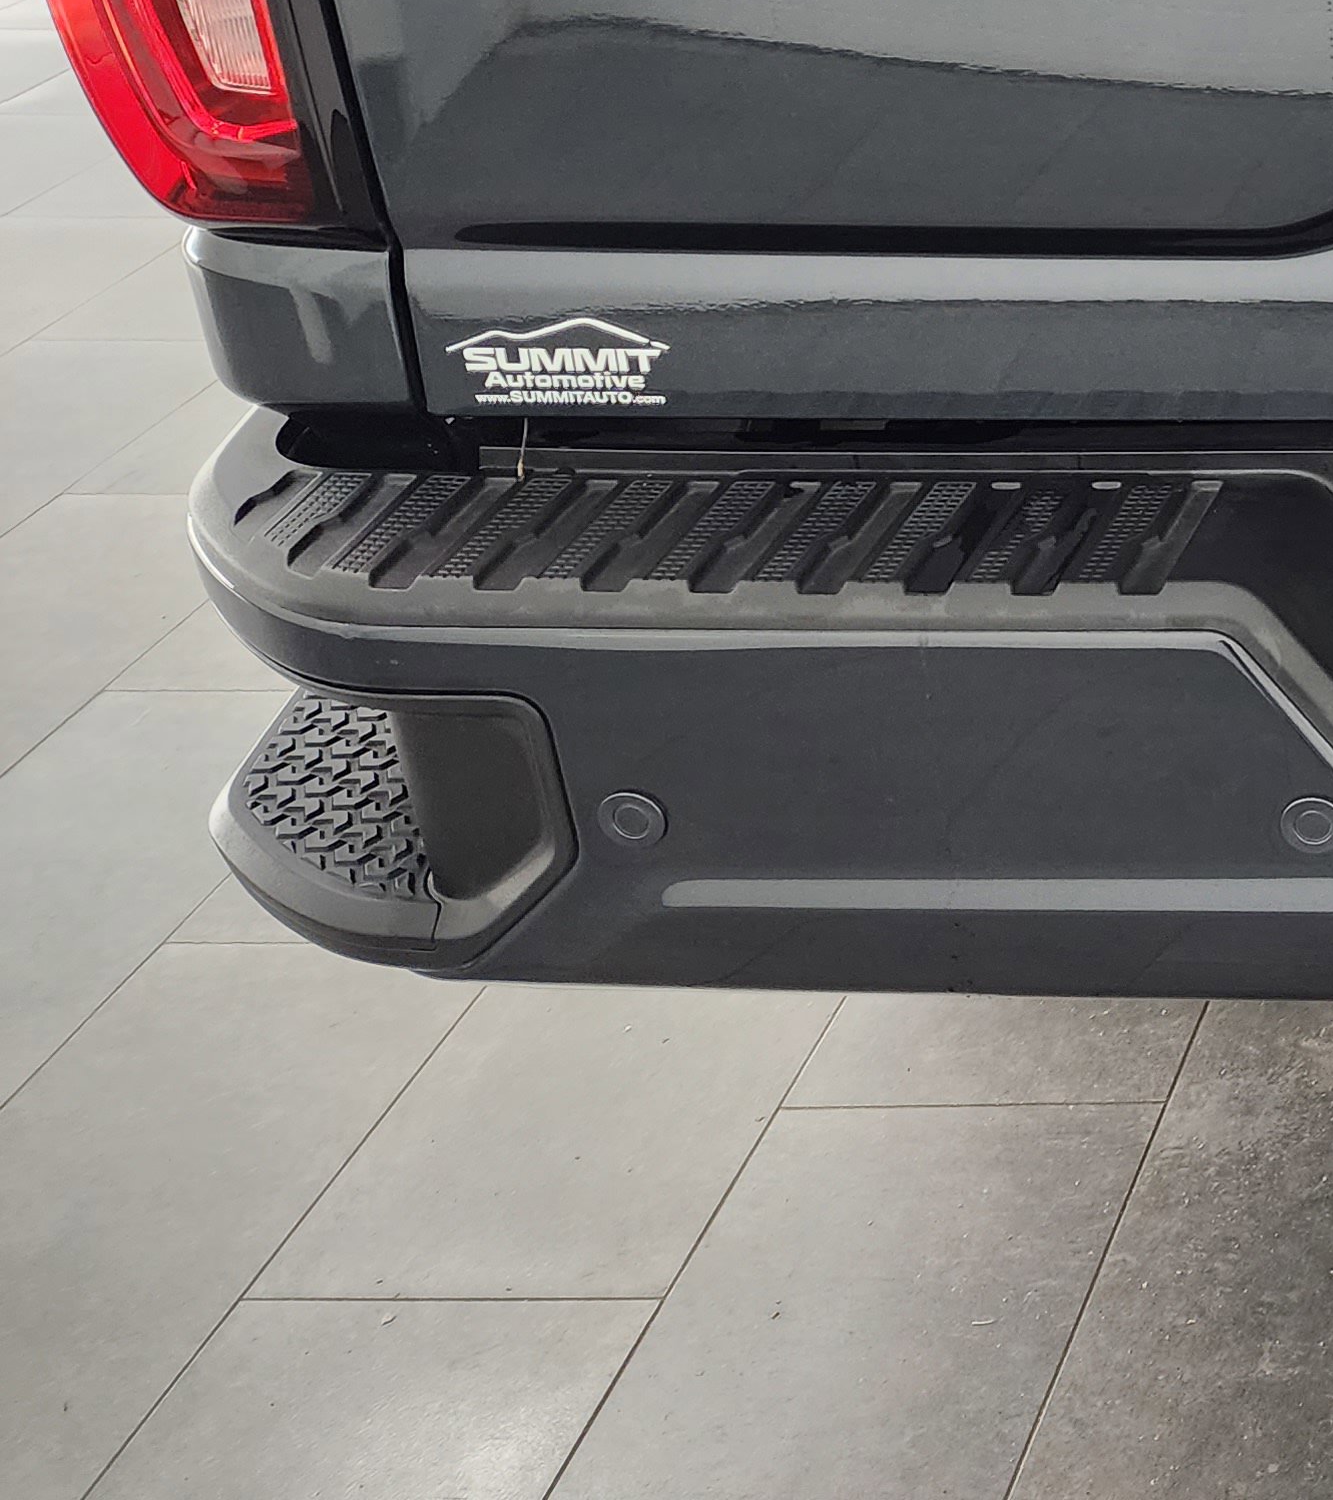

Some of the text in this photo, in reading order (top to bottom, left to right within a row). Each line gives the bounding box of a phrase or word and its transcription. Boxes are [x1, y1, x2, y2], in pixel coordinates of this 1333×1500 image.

[463, 348, 661, 372] SUMMIT
[485, 372, 645, 389] Automotive
[475, 391, 667, 404] www.SUMMITAUTO.com
